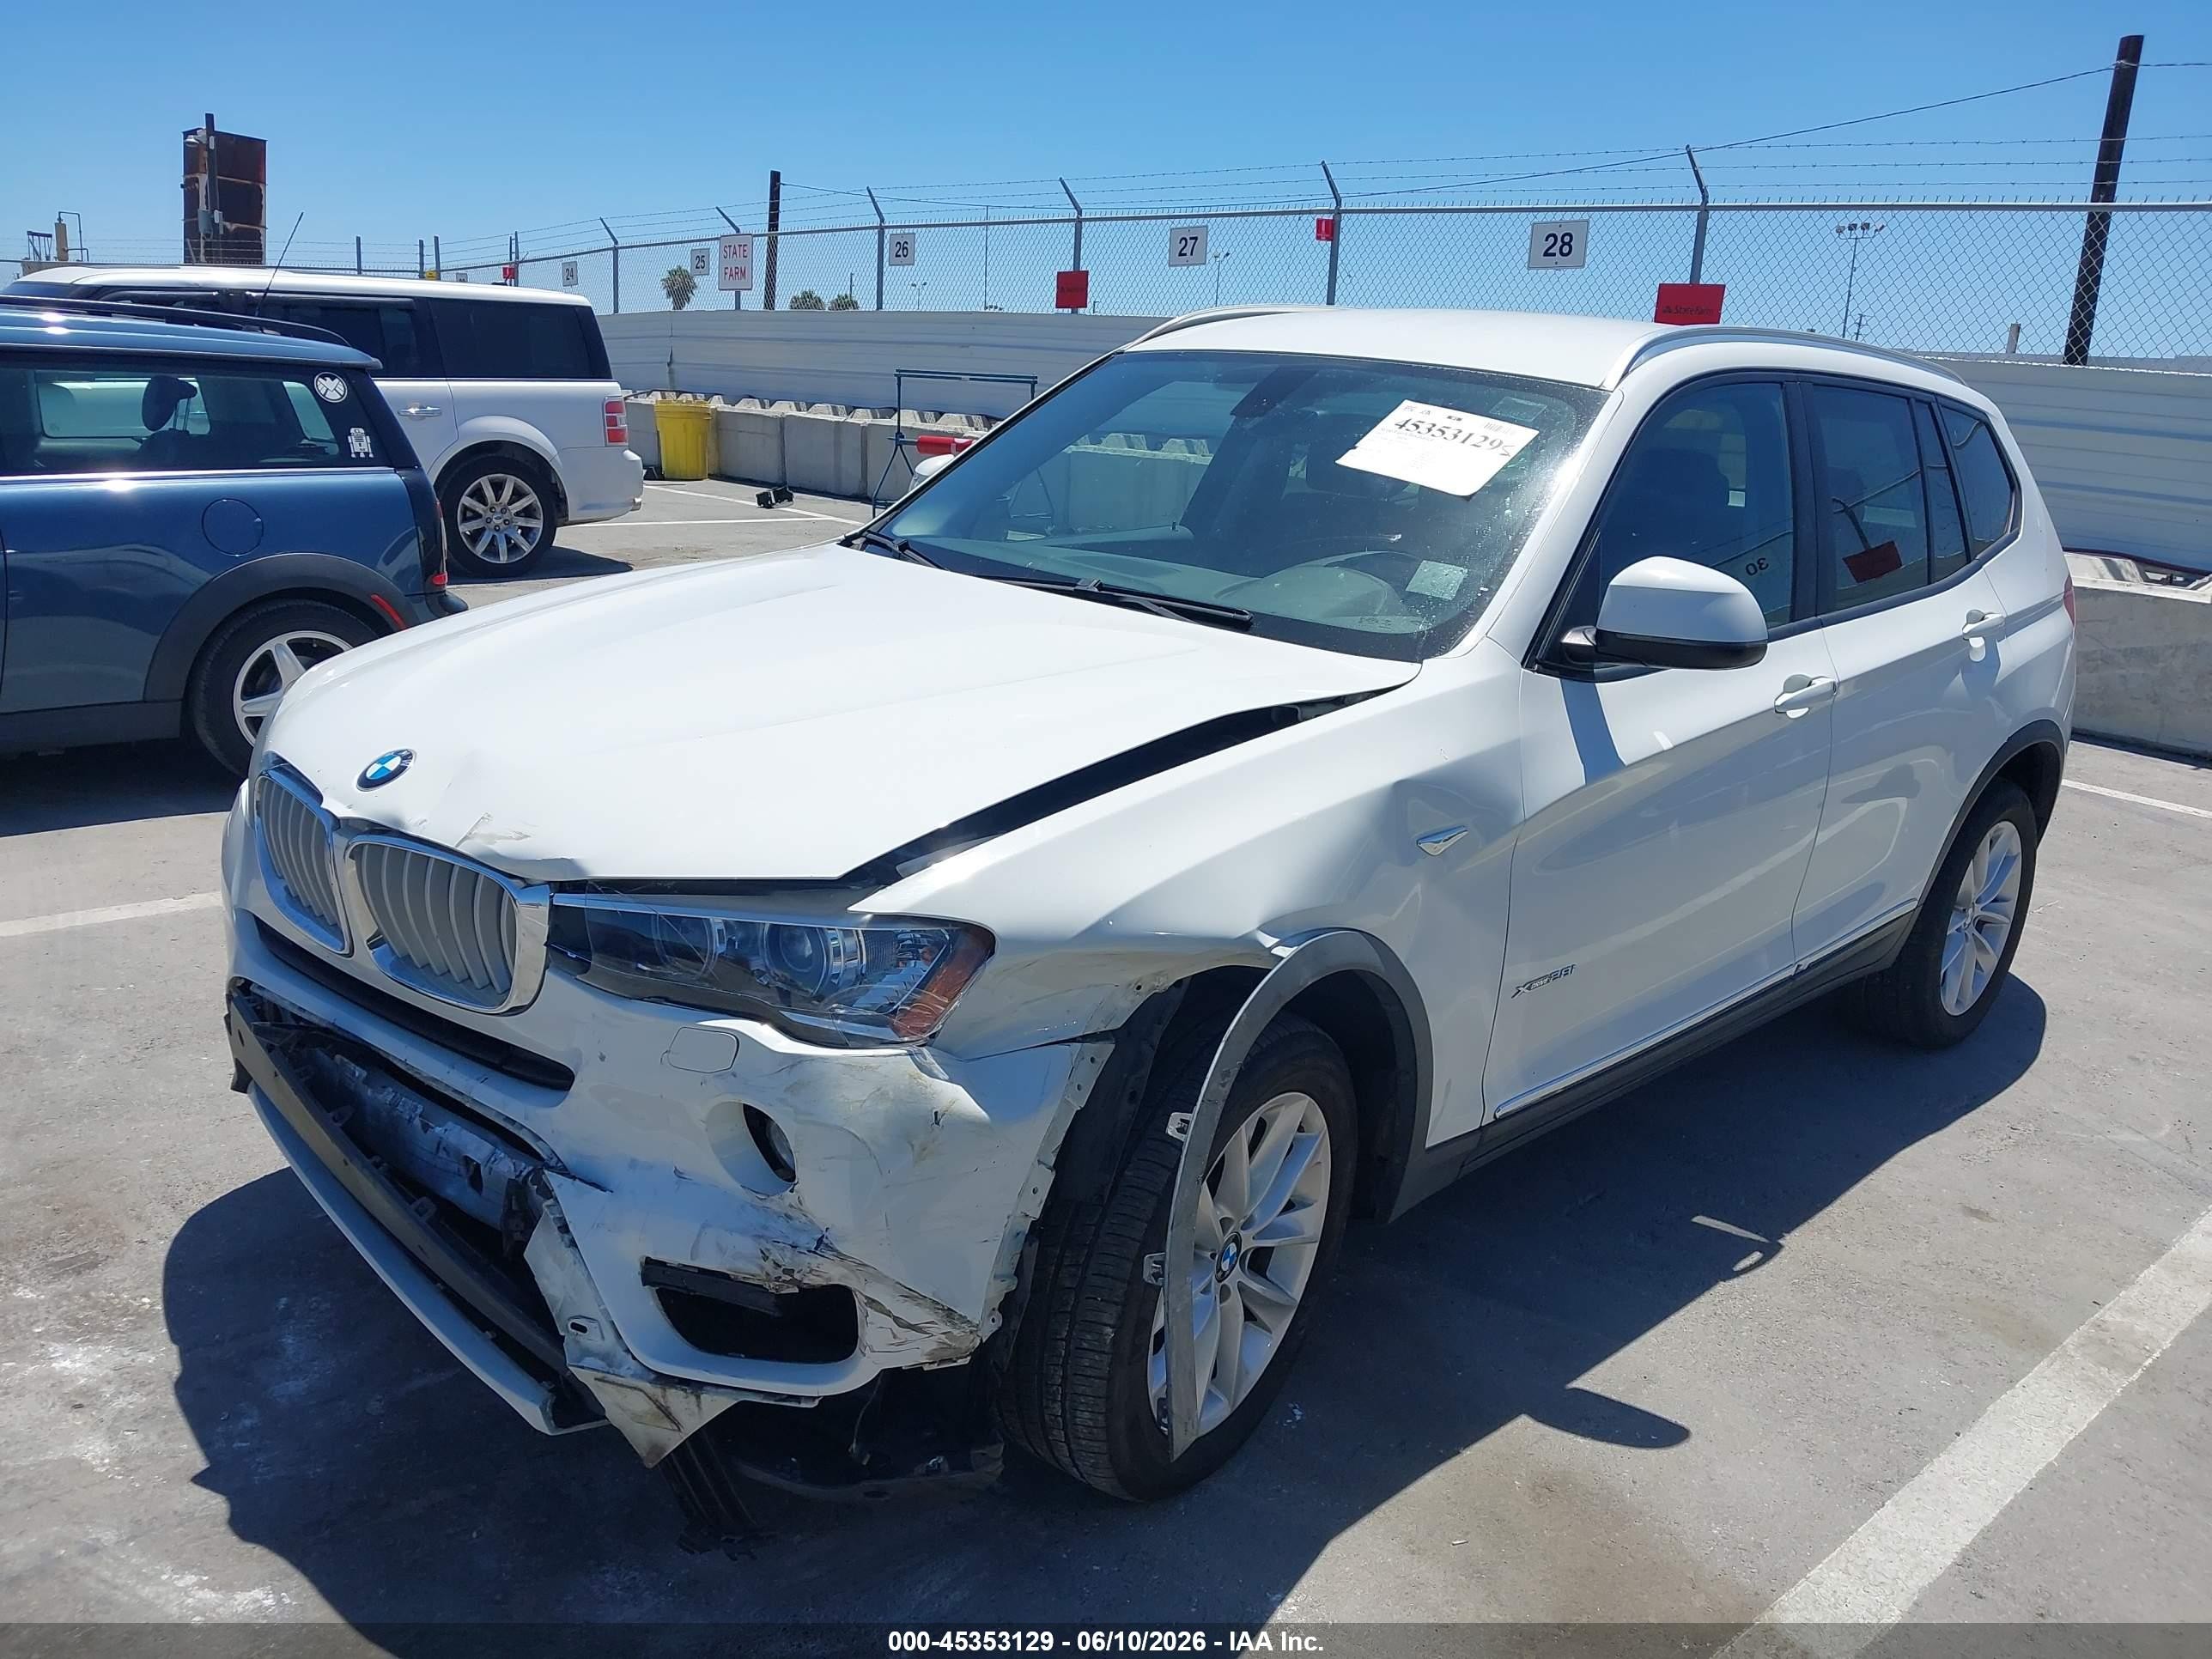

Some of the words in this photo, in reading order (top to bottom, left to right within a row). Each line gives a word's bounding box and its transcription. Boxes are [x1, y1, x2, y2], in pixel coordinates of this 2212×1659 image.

[723, 244, 748, 259] STATE
[895, 240, 908, 258] 26
[1177, 236, 1199, 257] 27
[1543, 232, 1573, 258] 28
[695, 255, 706, 270] 25
[565, 267, 574, 281] 24
[724, 265, 746, 281] FARM
[1394, 418, 1504, 451] 45353129
